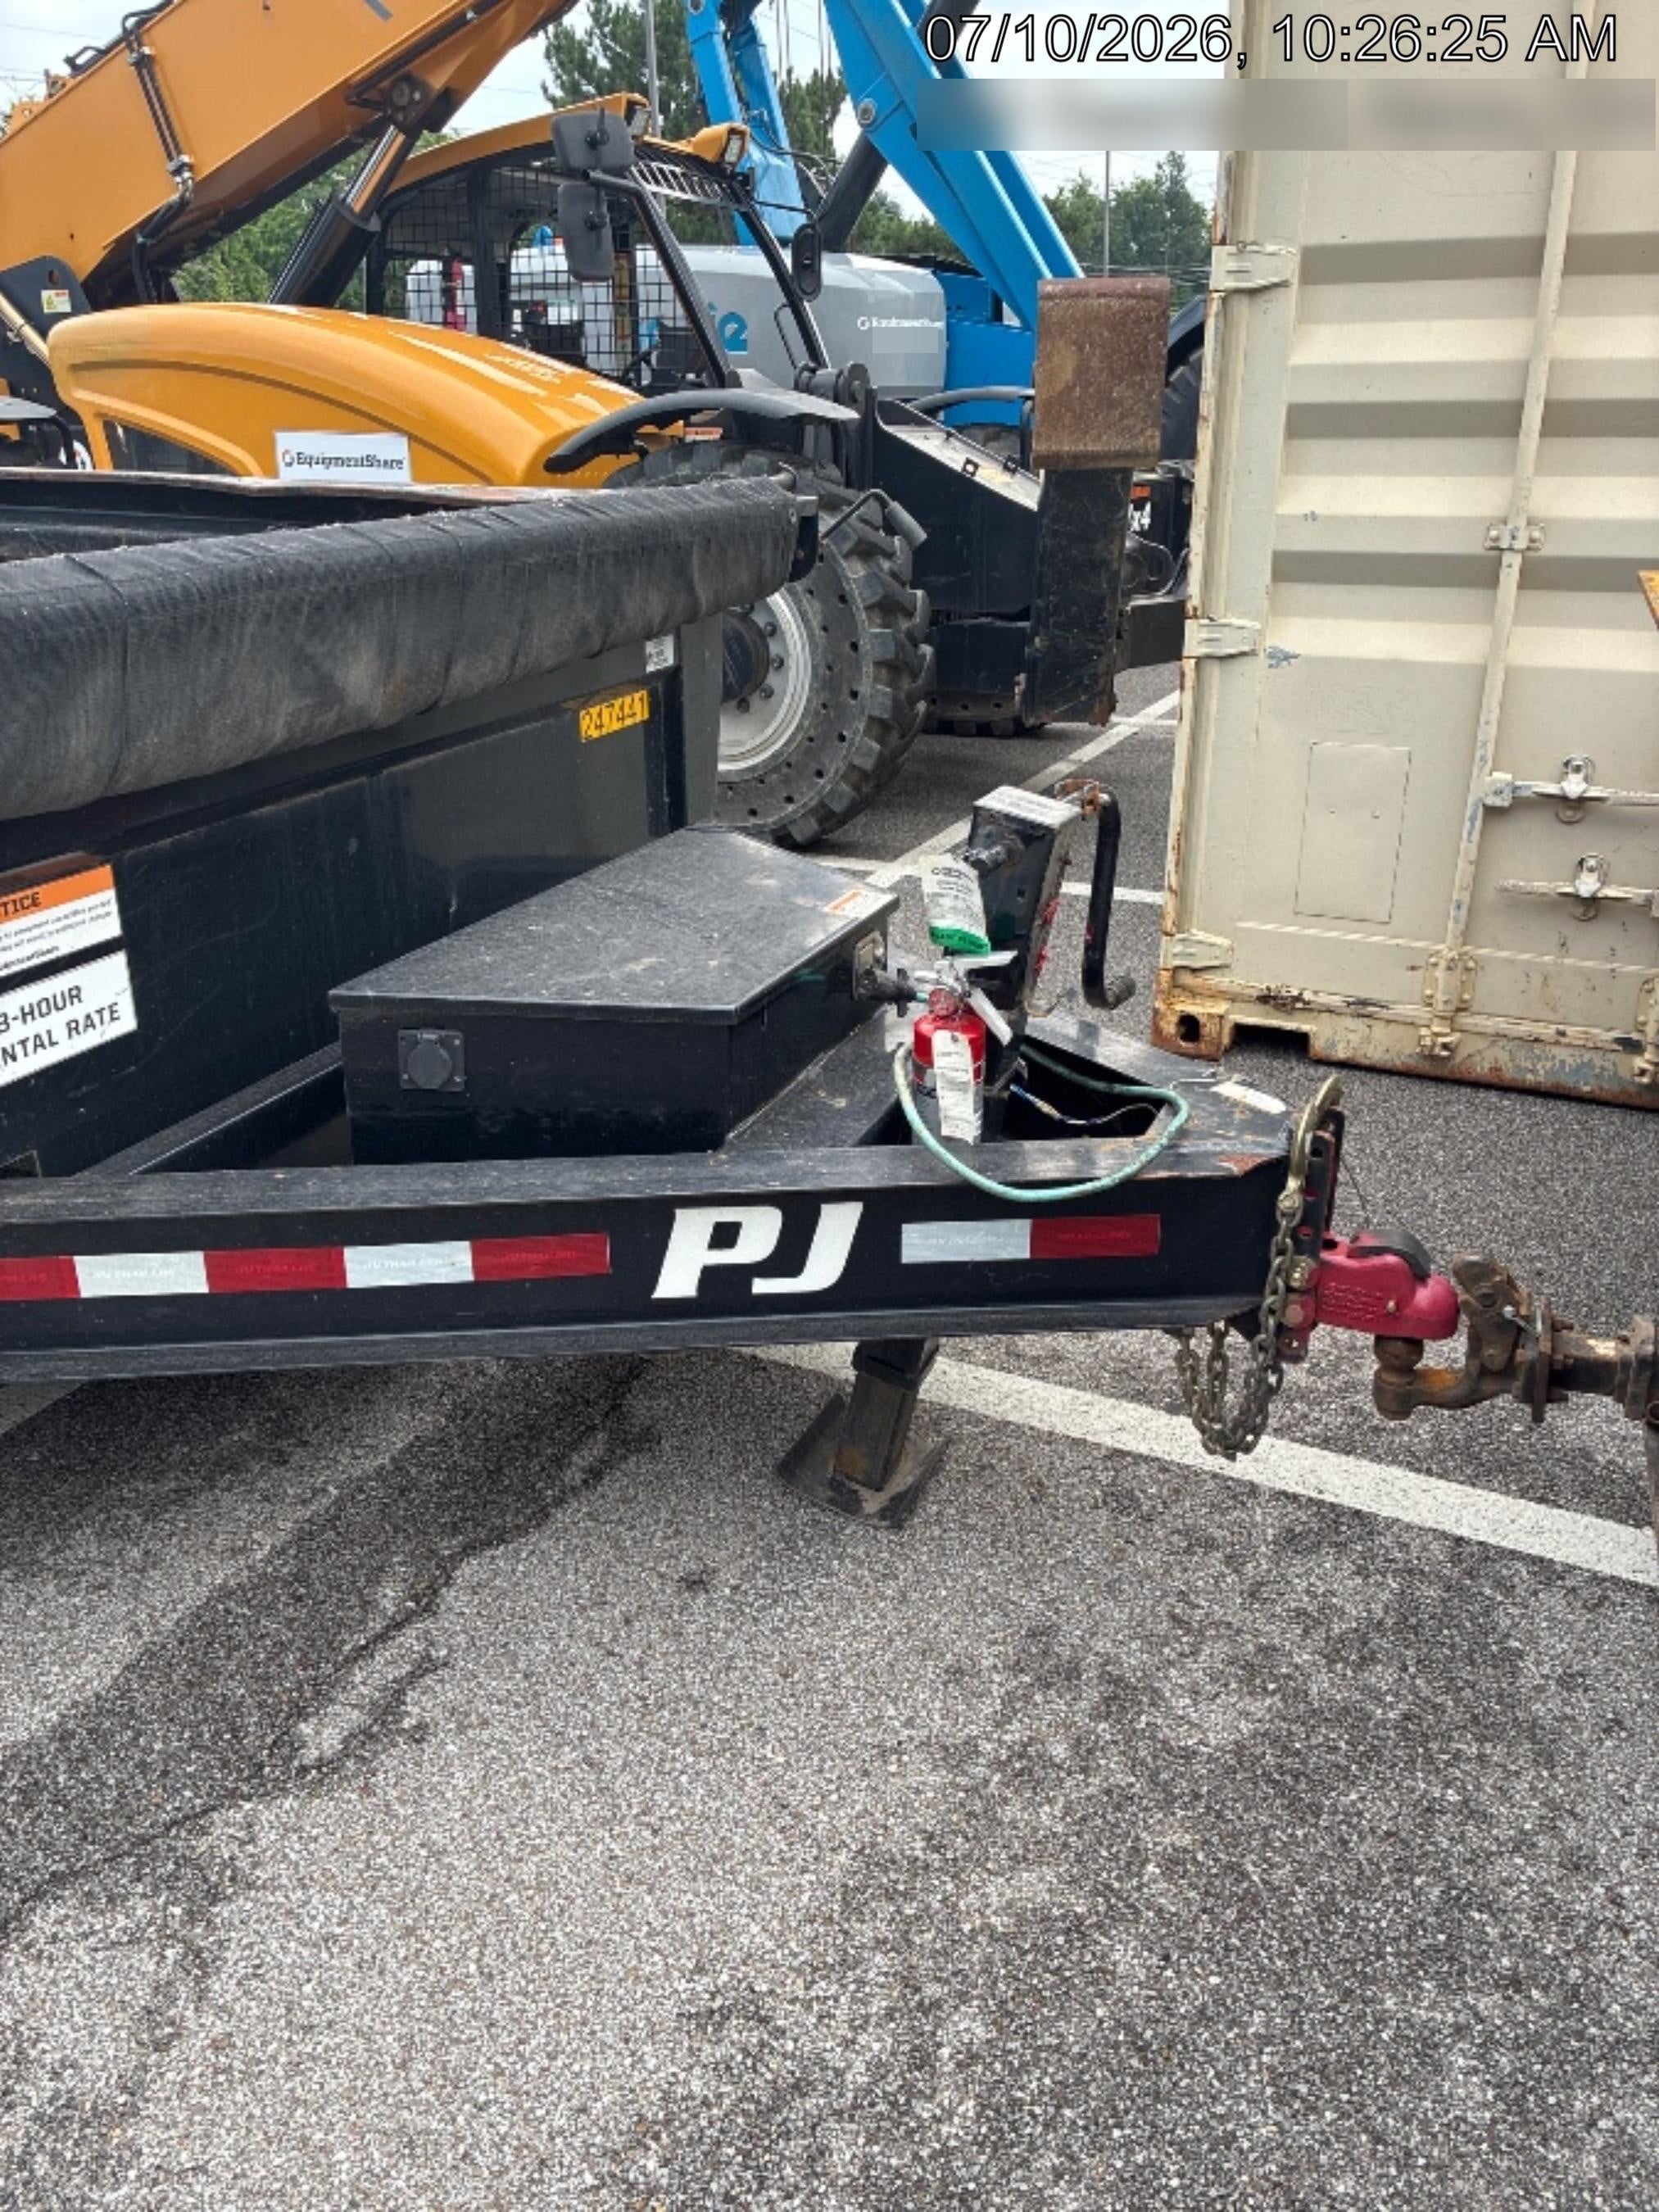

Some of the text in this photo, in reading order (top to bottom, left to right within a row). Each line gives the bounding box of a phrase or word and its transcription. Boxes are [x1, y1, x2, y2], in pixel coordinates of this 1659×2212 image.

[296, 451, 405, 470] EquipmentShare
[582, 691, 646, 741] 247441
[66, 1002, 120, 1040] RATE
[650, 1201, 864, 1299] PJ
